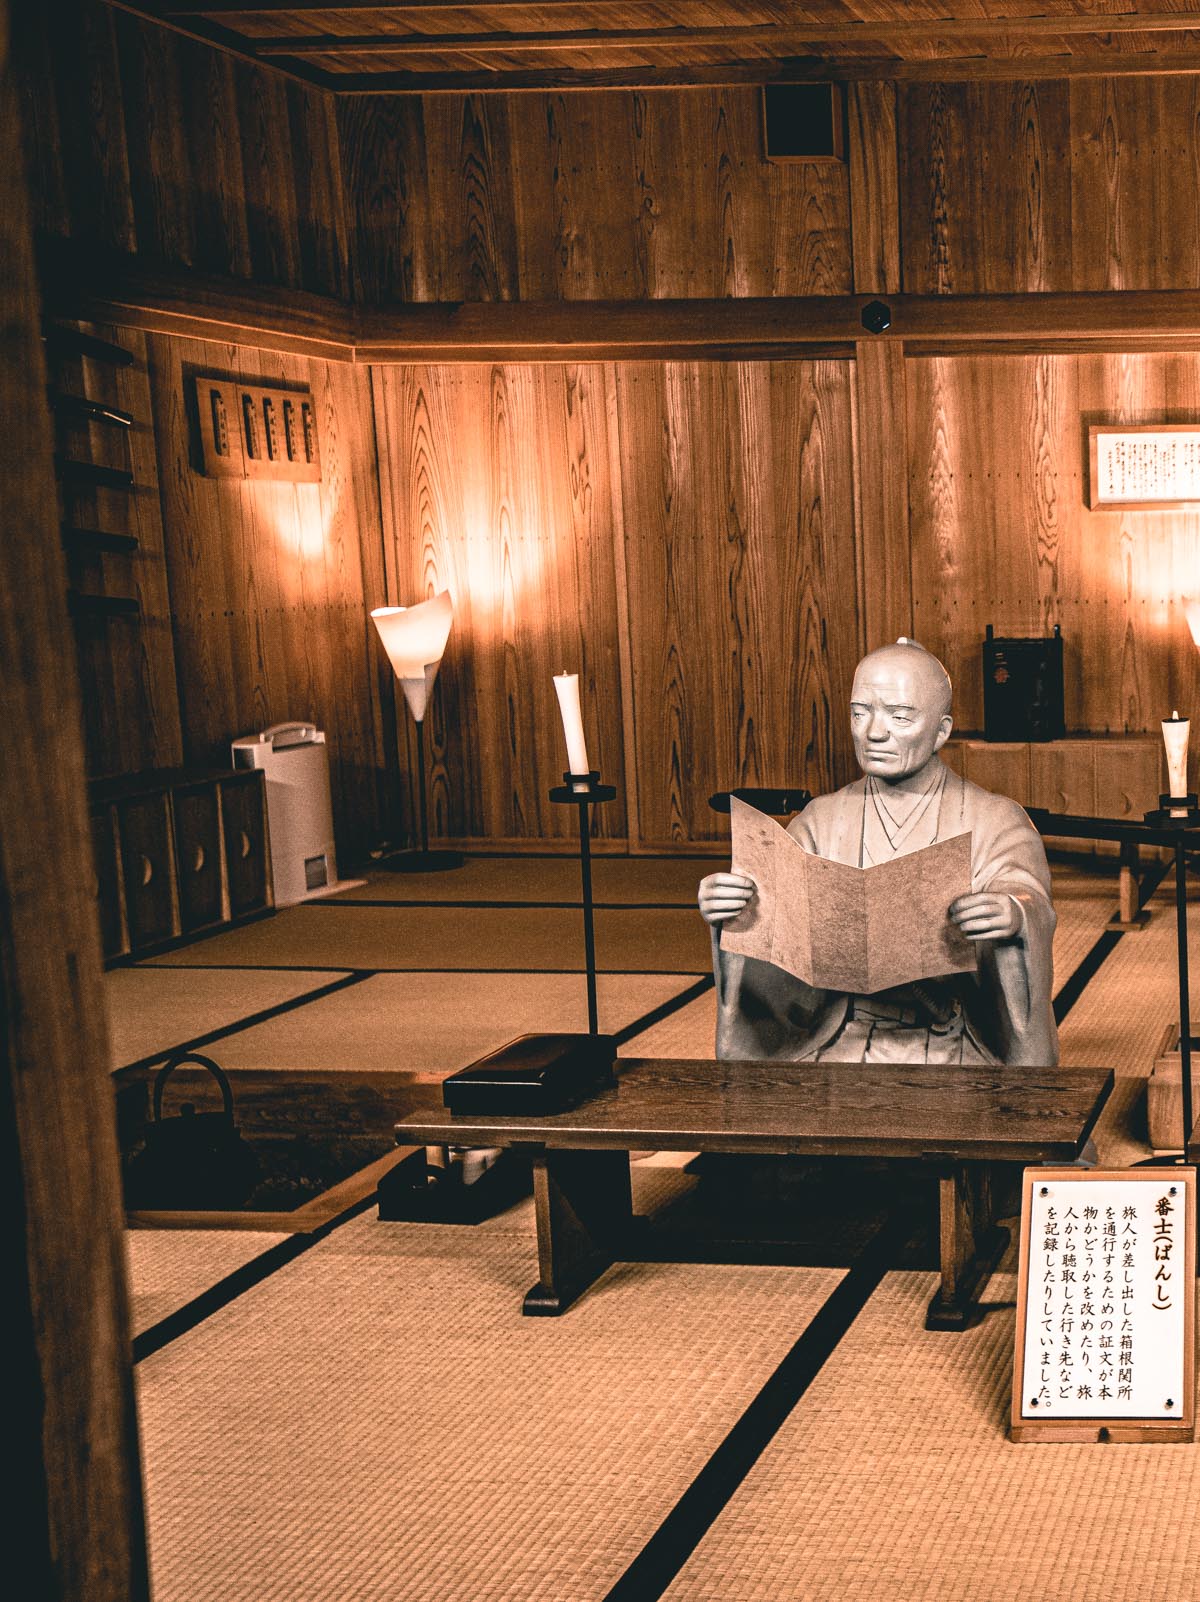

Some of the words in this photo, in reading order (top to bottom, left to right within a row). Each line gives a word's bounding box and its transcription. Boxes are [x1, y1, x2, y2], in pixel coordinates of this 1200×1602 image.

[1039, 1207, 1059, 1407] を記録したりしていました。
[1059, 1207, 1079, 1398] 人から聴取した行き先など
[1077, 1206, 1098, 1400] 物かどうかを改めたり、旅
[1098, 1207, 1117, 1400] を通行するための証文が本
[1118, 1206, 1137, 1400] 旅人が差し出した箱根関所
